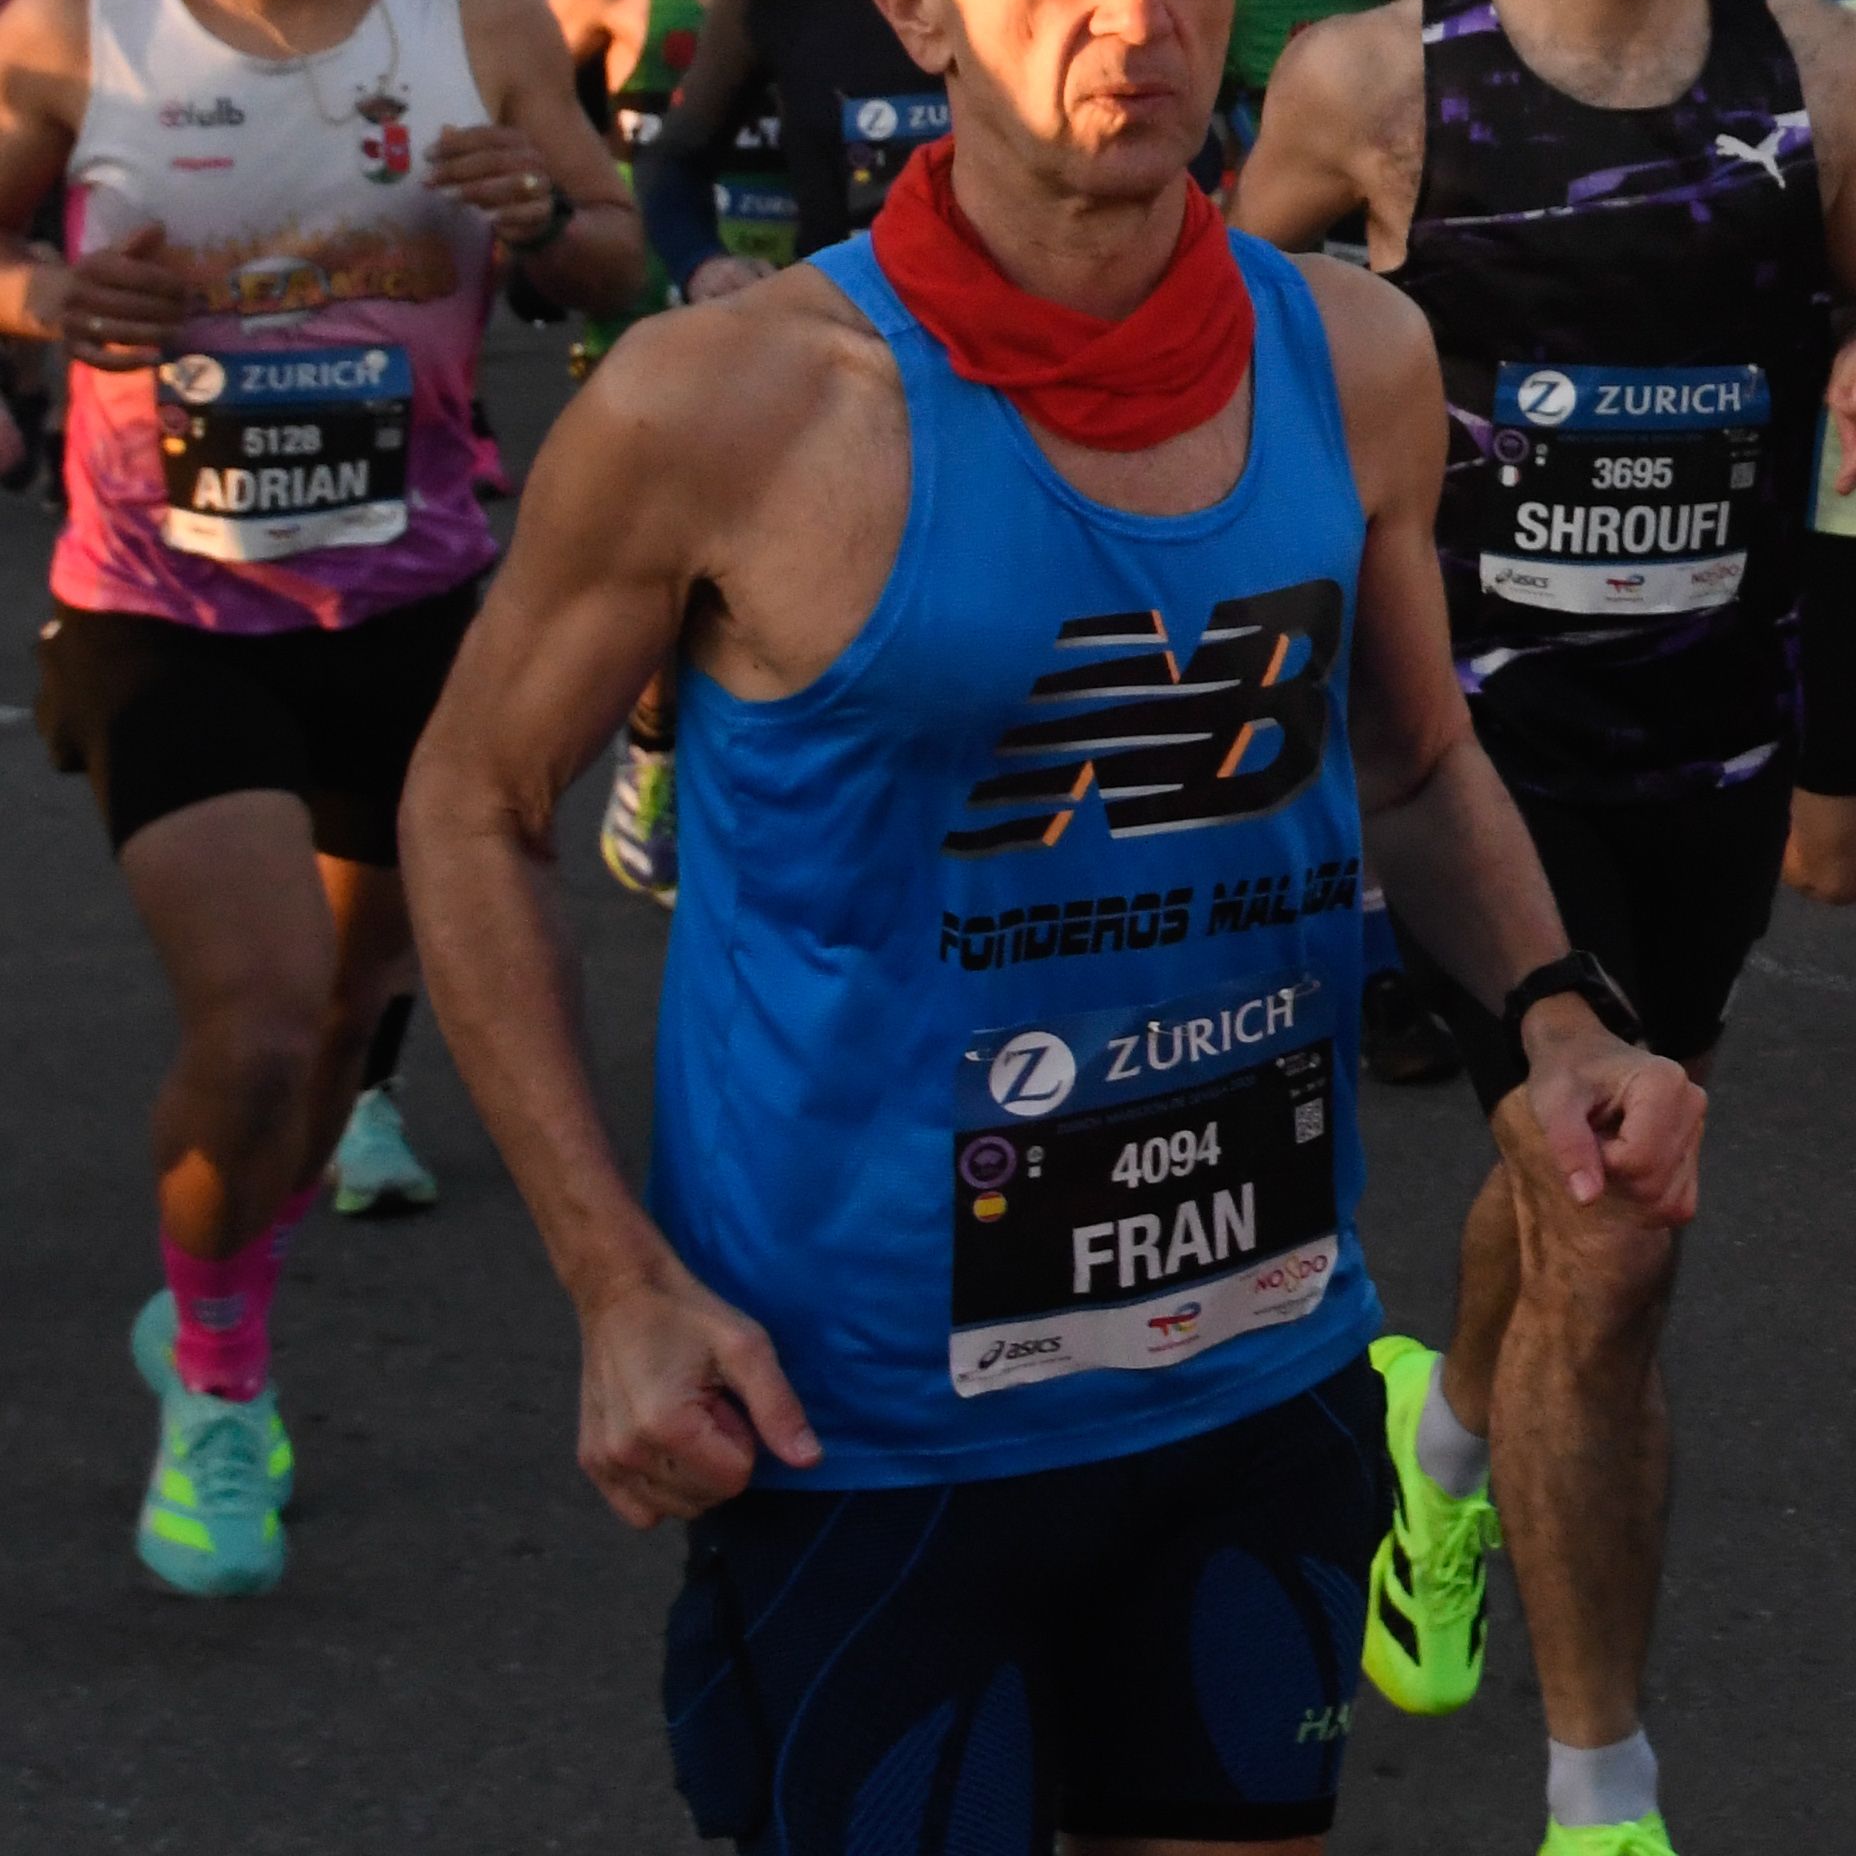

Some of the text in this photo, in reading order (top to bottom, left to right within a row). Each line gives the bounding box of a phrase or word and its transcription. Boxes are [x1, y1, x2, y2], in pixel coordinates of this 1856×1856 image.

[241, 360, 382, 391] ZURICH
[1594, 382, 1742, 415] ZURICH
[192, 459, 370, 512] ADRIAN
[1591, 457, 1673, 490] 3695
[1514, 500, 1730, 554] SHROUFI
[1105, 986, 1295, 1082] ZURICH
[1112, 1121, 1222, 1189] 4094
[1072, 1181, 1257, 1294] FRAN
[1004, 1335, 1062, 1359] asics
